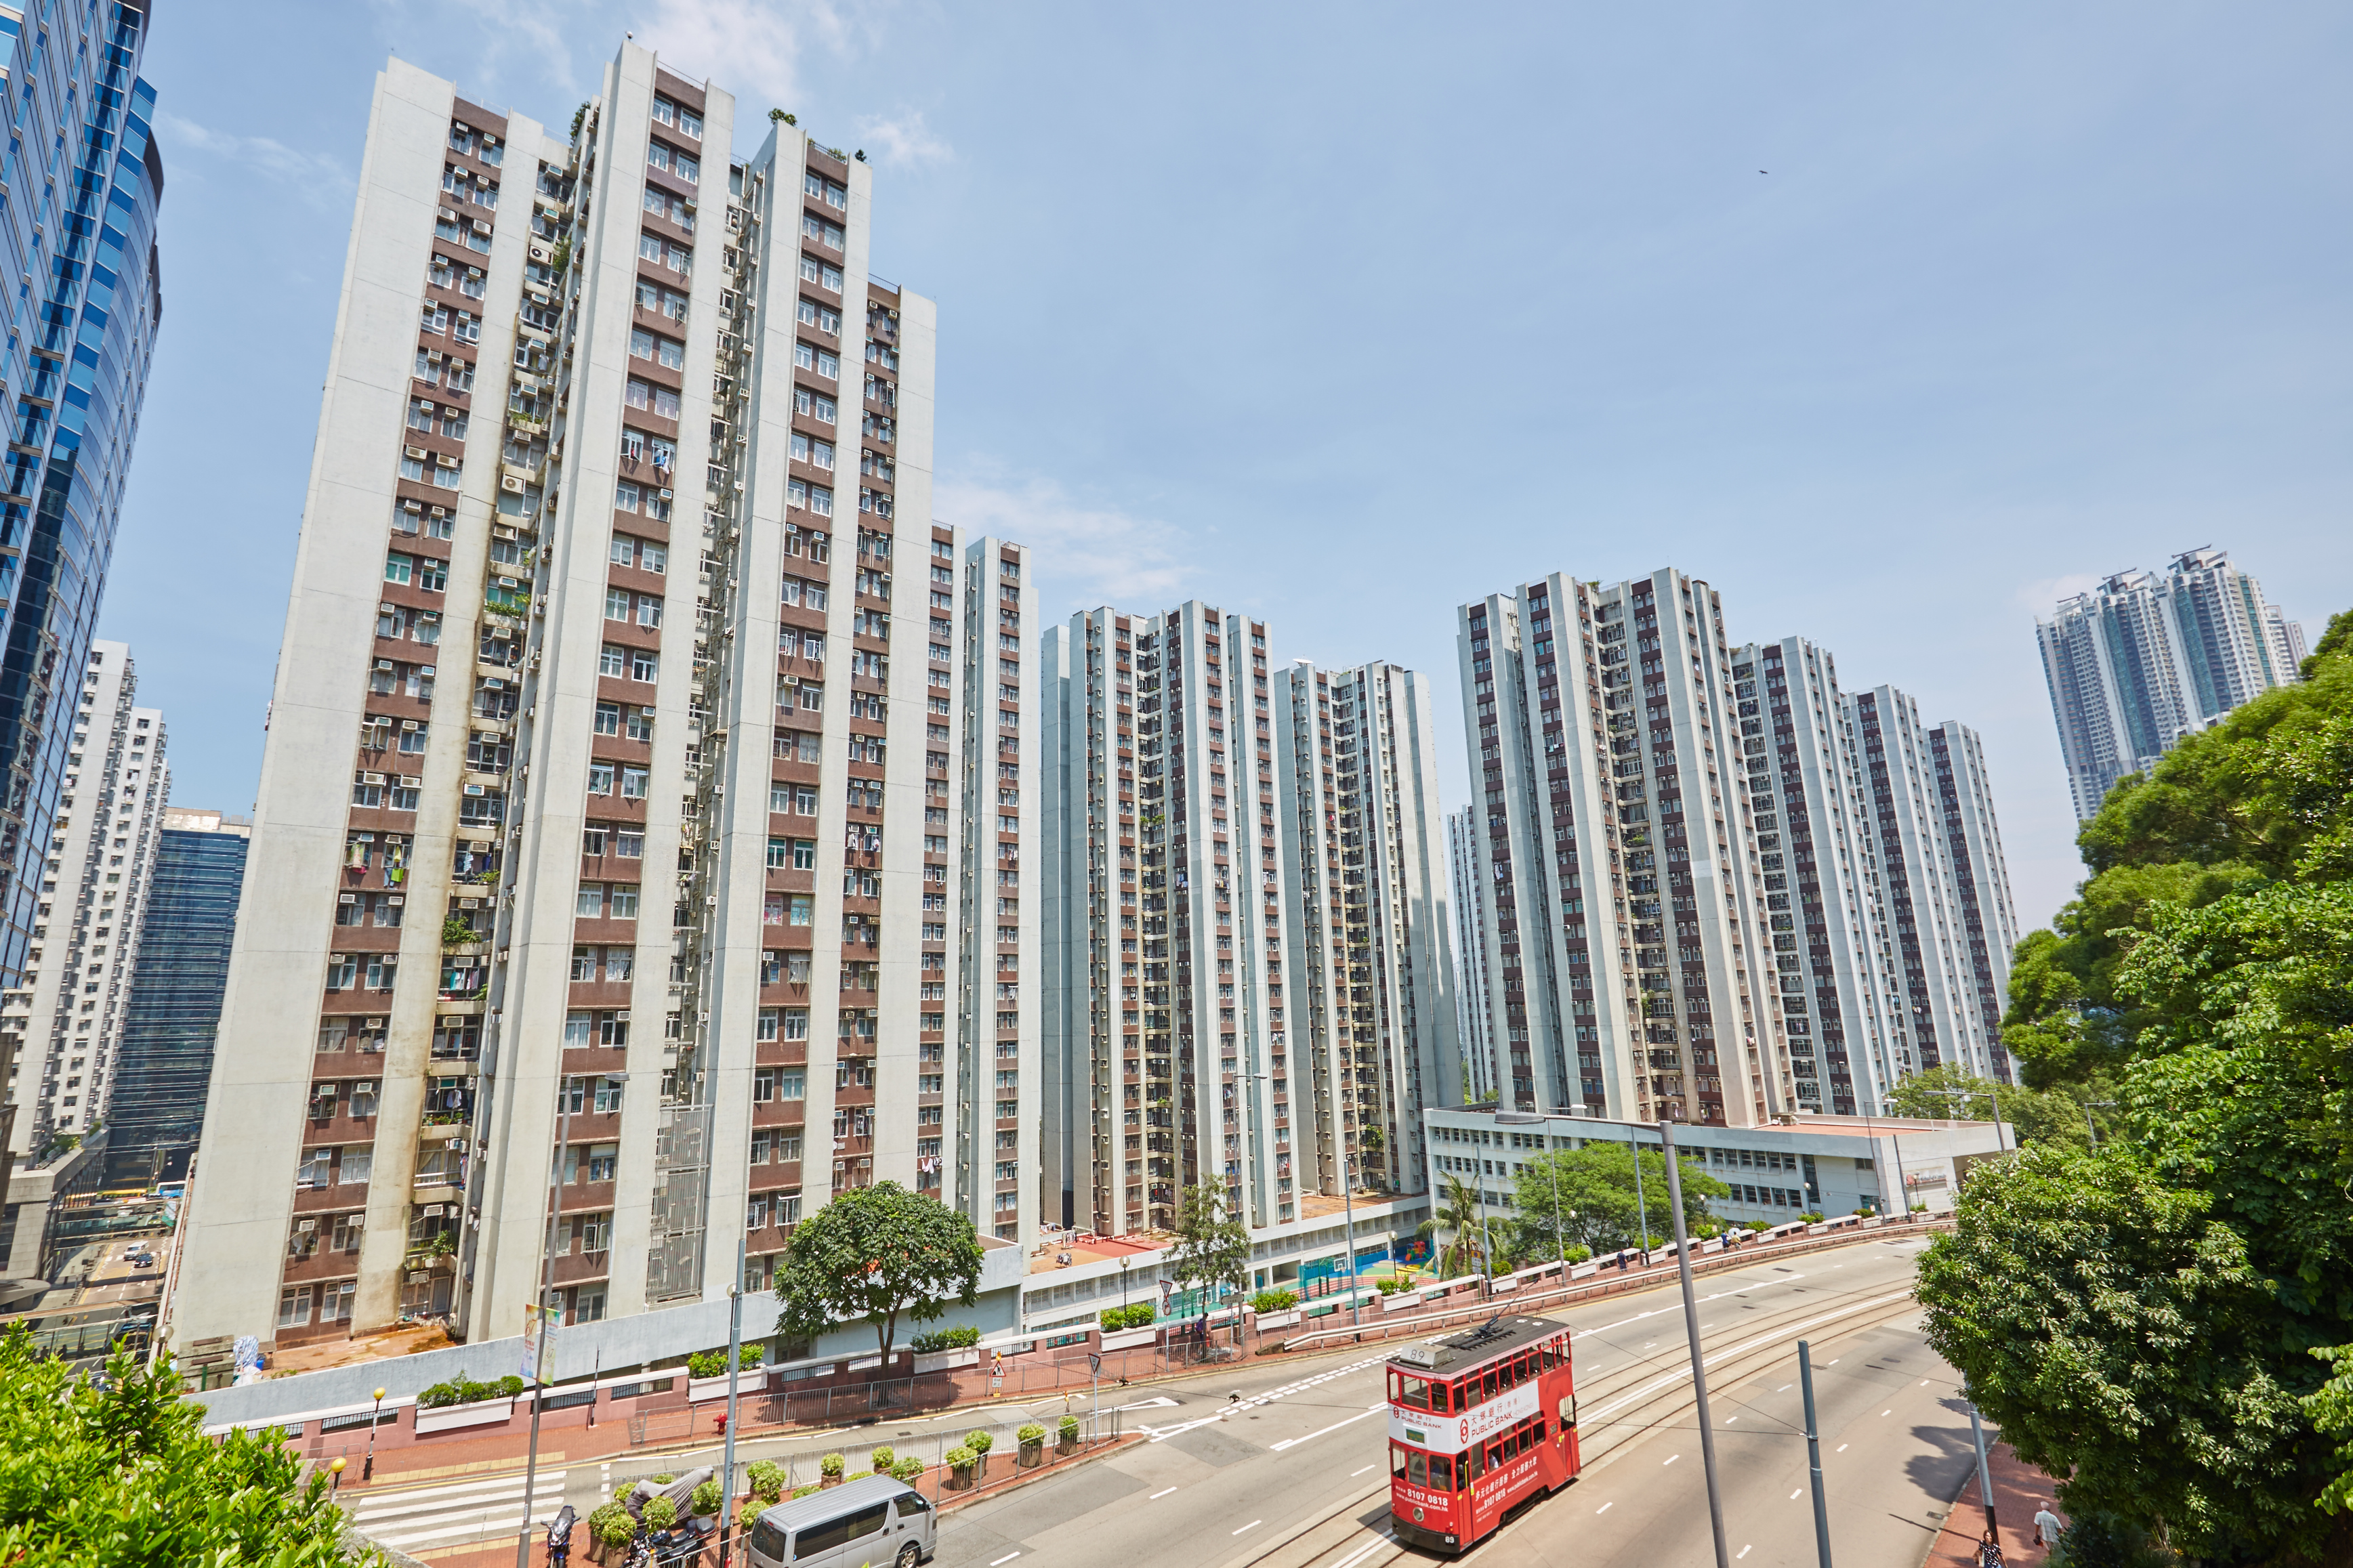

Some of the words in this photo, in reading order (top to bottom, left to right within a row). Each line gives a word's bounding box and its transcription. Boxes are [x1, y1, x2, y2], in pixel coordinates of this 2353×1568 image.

[525, 1319, 537, 1338] 67
[1411, 1349, 1425, 1361] 89
[1401, 1416, 1421, 1425] PUBLIC
[1472, 1420, 1494, 1437] PUBLIC
[1495, 1411, 1513, 1426] BANK
[1396, 1492, 1449, 1512] www.publicbank.com.hk
[1407, 1488, 1425, 1501] 8107
[1428, 1494, 1449, 1506] 0818
[1484, 1494, 1495, 1508] 8107
[1495, 1487, 1505, 1502] 0818
